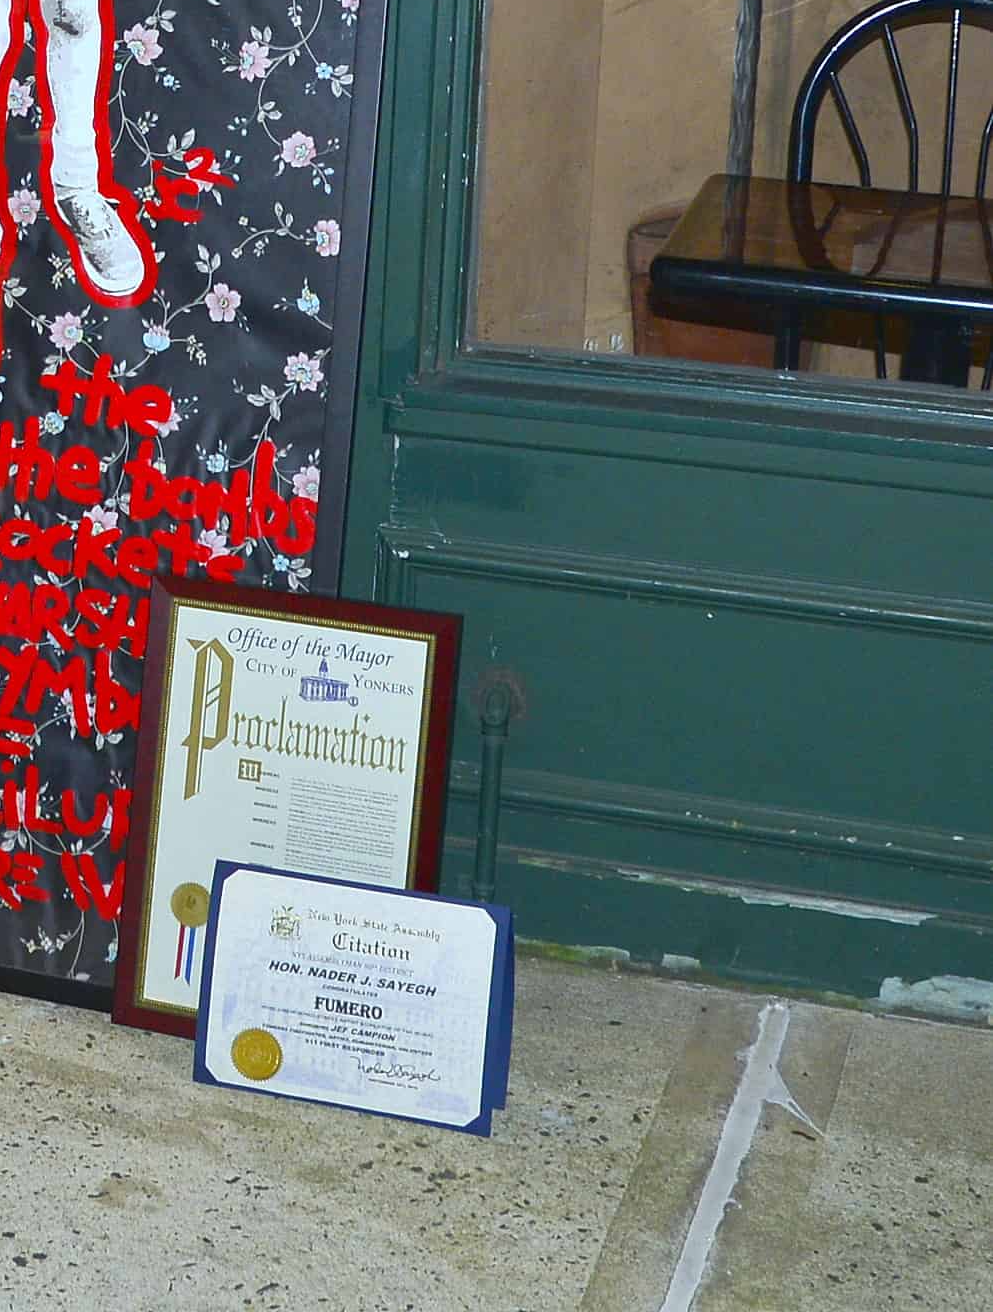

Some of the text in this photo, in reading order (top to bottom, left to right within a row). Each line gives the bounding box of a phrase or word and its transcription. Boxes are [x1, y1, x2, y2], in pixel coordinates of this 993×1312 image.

[39, 353, 174, 437] the
[227, 626, 395, 671] Office of the Mayor
[245, 657, 414, 696] CITY OF YONKERS
[181, 637, 408, 801] Proclamation
[307, 907, 441, 944] New York State Assembly
[332, 930, 411, 961] Citation
[268, 959, 304, 976] HON.
[307, 966, 357, 985] NADER
[360, 976, 373, 988] J.
[376, 978, 438, 998] SAYEGH
[314, 995, 384, 1021] FUMERO
[350, 1028, 397, 1043] CAMPION
